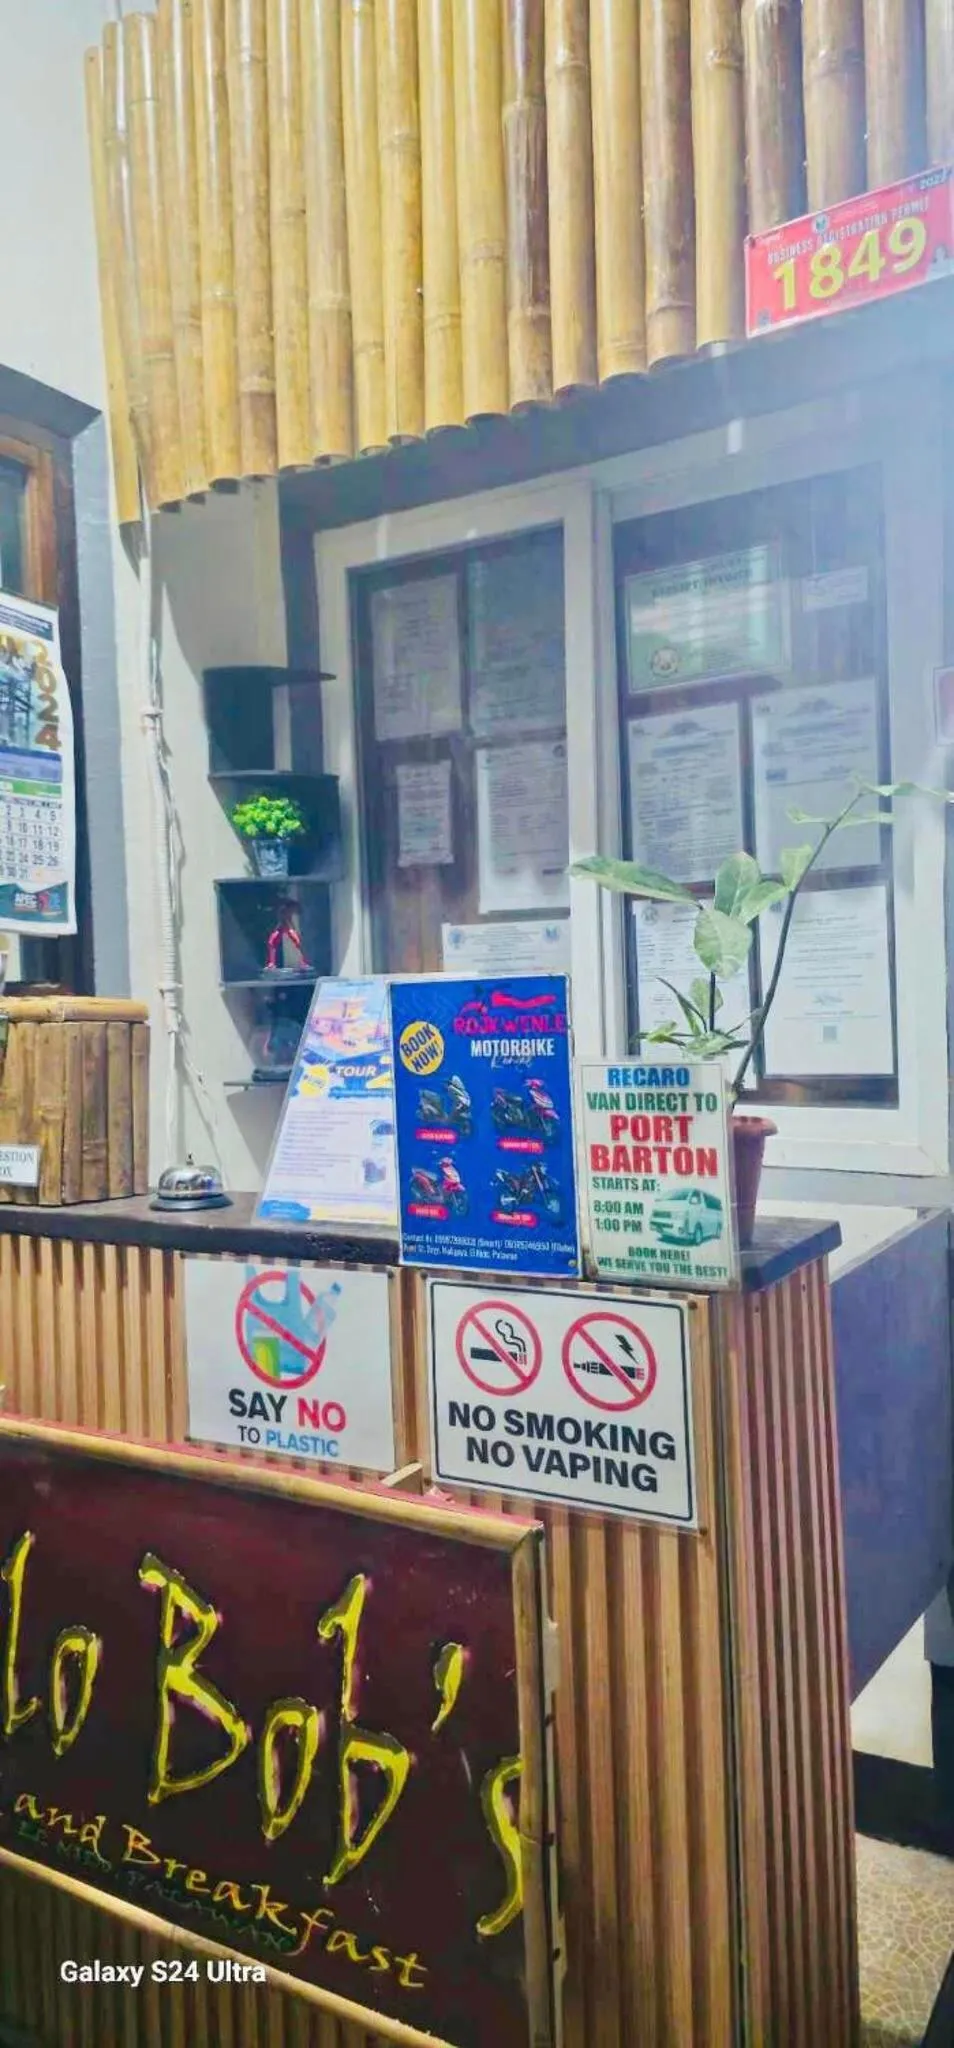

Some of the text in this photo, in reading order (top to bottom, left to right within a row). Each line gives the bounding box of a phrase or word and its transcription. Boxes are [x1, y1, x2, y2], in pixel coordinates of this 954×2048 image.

[773, 216, 927, 311] 1849
[401, 1024, 436, 1058] BOOK
[411, 1040, 439, 1072] NOW!
[471, 1038, 555, 1057] MOTORBIKE
[336, 1064, 377, 1077] TOUR
[607, 1066, 690, 1087] RECARO
[587, 1092, 718, 1112] VAN DIRECT TO
[610, 1114, 694, 1143] PORT
[590, 1144, 718, 1176] BARTON
[592, 1176, 661, 1191] STARTS AT:
[593, 1200, 644, 1215] 8:00 AM
[594, 1218, 643, 1233] 1:00 PM
[615, 1258, 646, 1272] SERVE
[649, 1261, 670, 1273] YOU
[672, 1263, 692, 1276] THE
[695, 1265, 728, 1277] BEST!
[628, 1246, 690, 1260] BOOK HERE!
[229, 1388, 347, 1433] SAY NO
[237, 1425, 339, 1457] TO PLASTIC
[449, 1401, 676, 1461] NO SMOKING
[466, 1436, 659, 1493] NO VAPING
[138, 1552, 524, 1938] Bob's
[14, 1793, 428, 1989] and Breakfast
